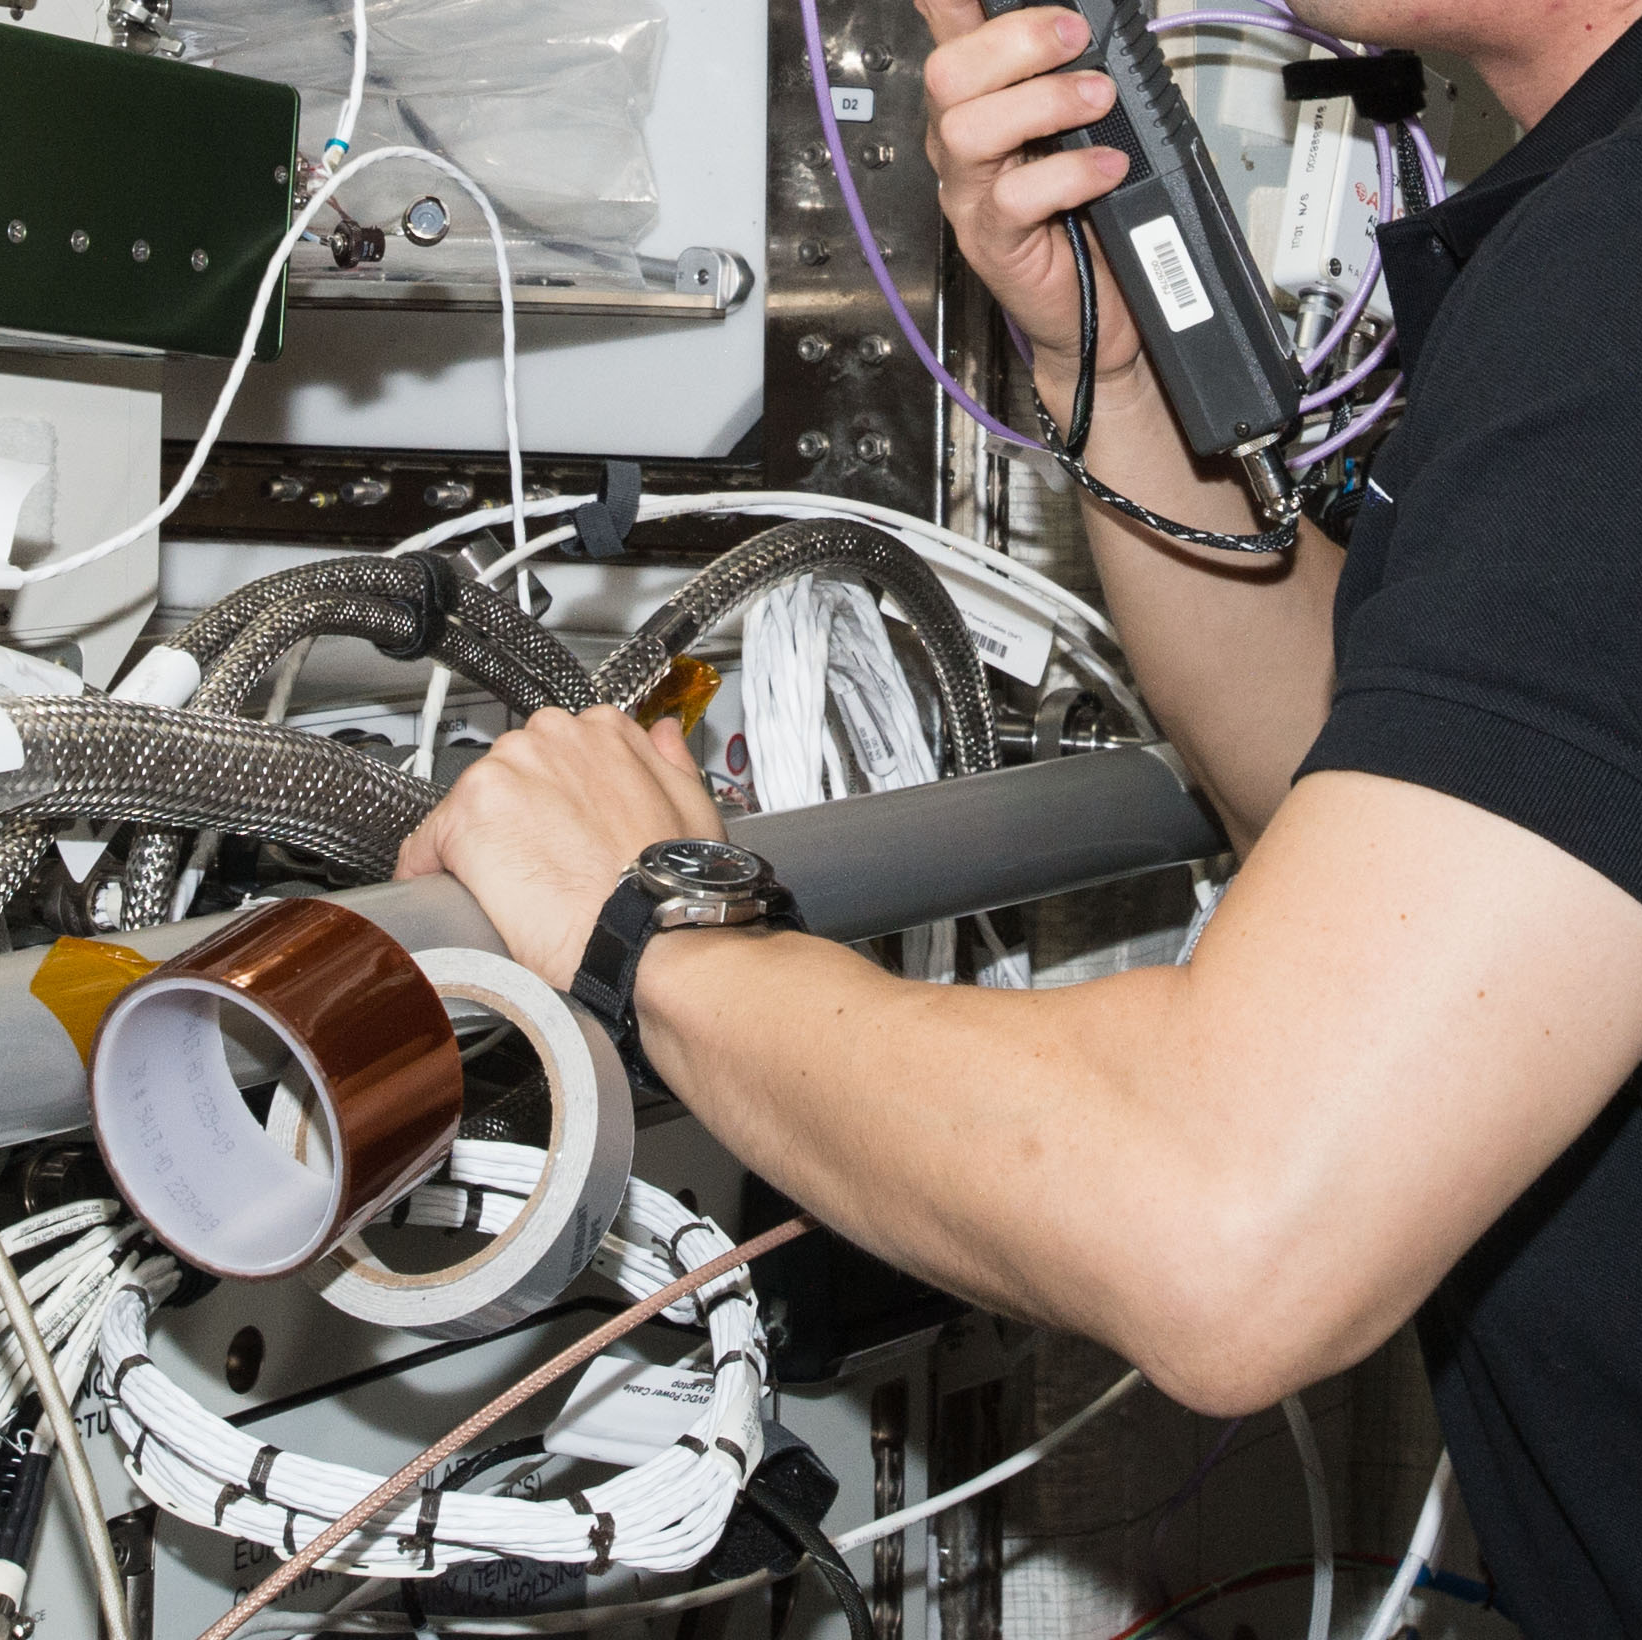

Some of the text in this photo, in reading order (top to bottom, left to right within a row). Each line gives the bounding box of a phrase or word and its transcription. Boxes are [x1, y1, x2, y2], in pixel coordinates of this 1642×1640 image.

[842, 98, 859, 111] D2
[671, 1380, 704, 1392] Laptop
[623, 1383, 710, 1405] 6VDC Power Cable
